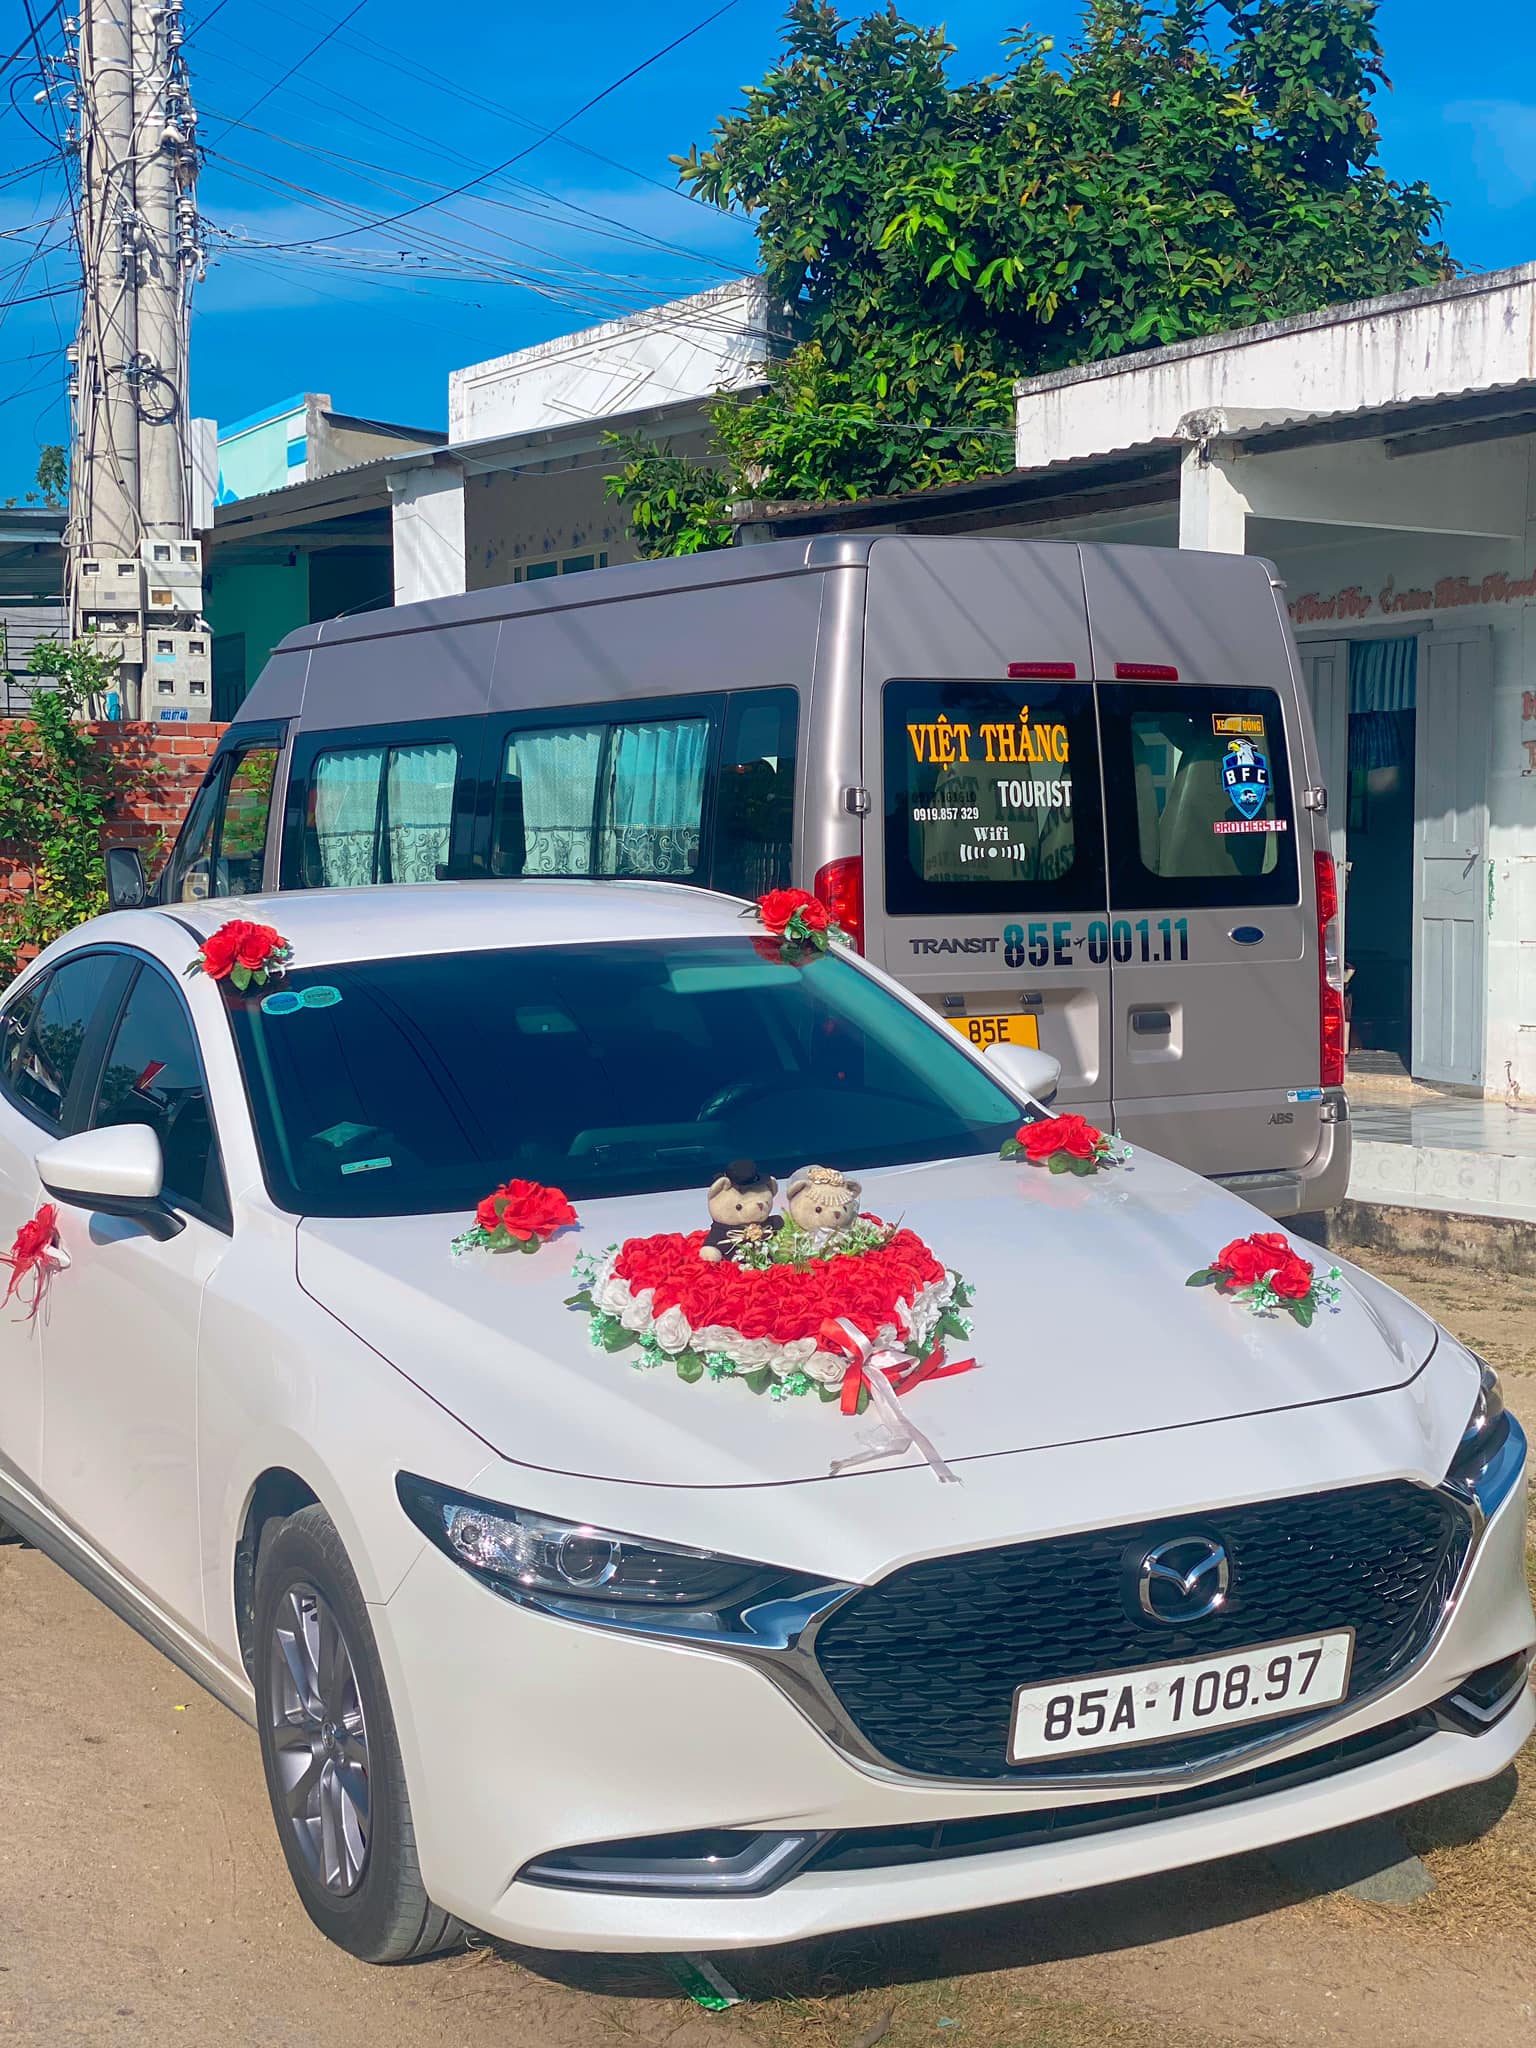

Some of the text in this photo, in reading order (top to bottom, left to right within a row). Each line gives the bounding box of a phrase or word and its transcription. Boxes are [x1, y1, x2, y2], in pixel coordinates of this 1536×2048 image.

[906, 705, 1069, 771] VIỆT THẮNG
[997, 780, 1073, 807] TOURIST
[913, 807, 980, 821] 0919.857 329
[973, 826, 1010, 842] Wifi
[1214, 820, 1272, 833] BROTHERS
[909, 937, 1000, 954] TRANSIT
[968, 1018, 1010, 1043] 85E
[1267, 1112, 1294, 1125] ABS
[1043, 1648, 1323, 1742] 85A-108.97
